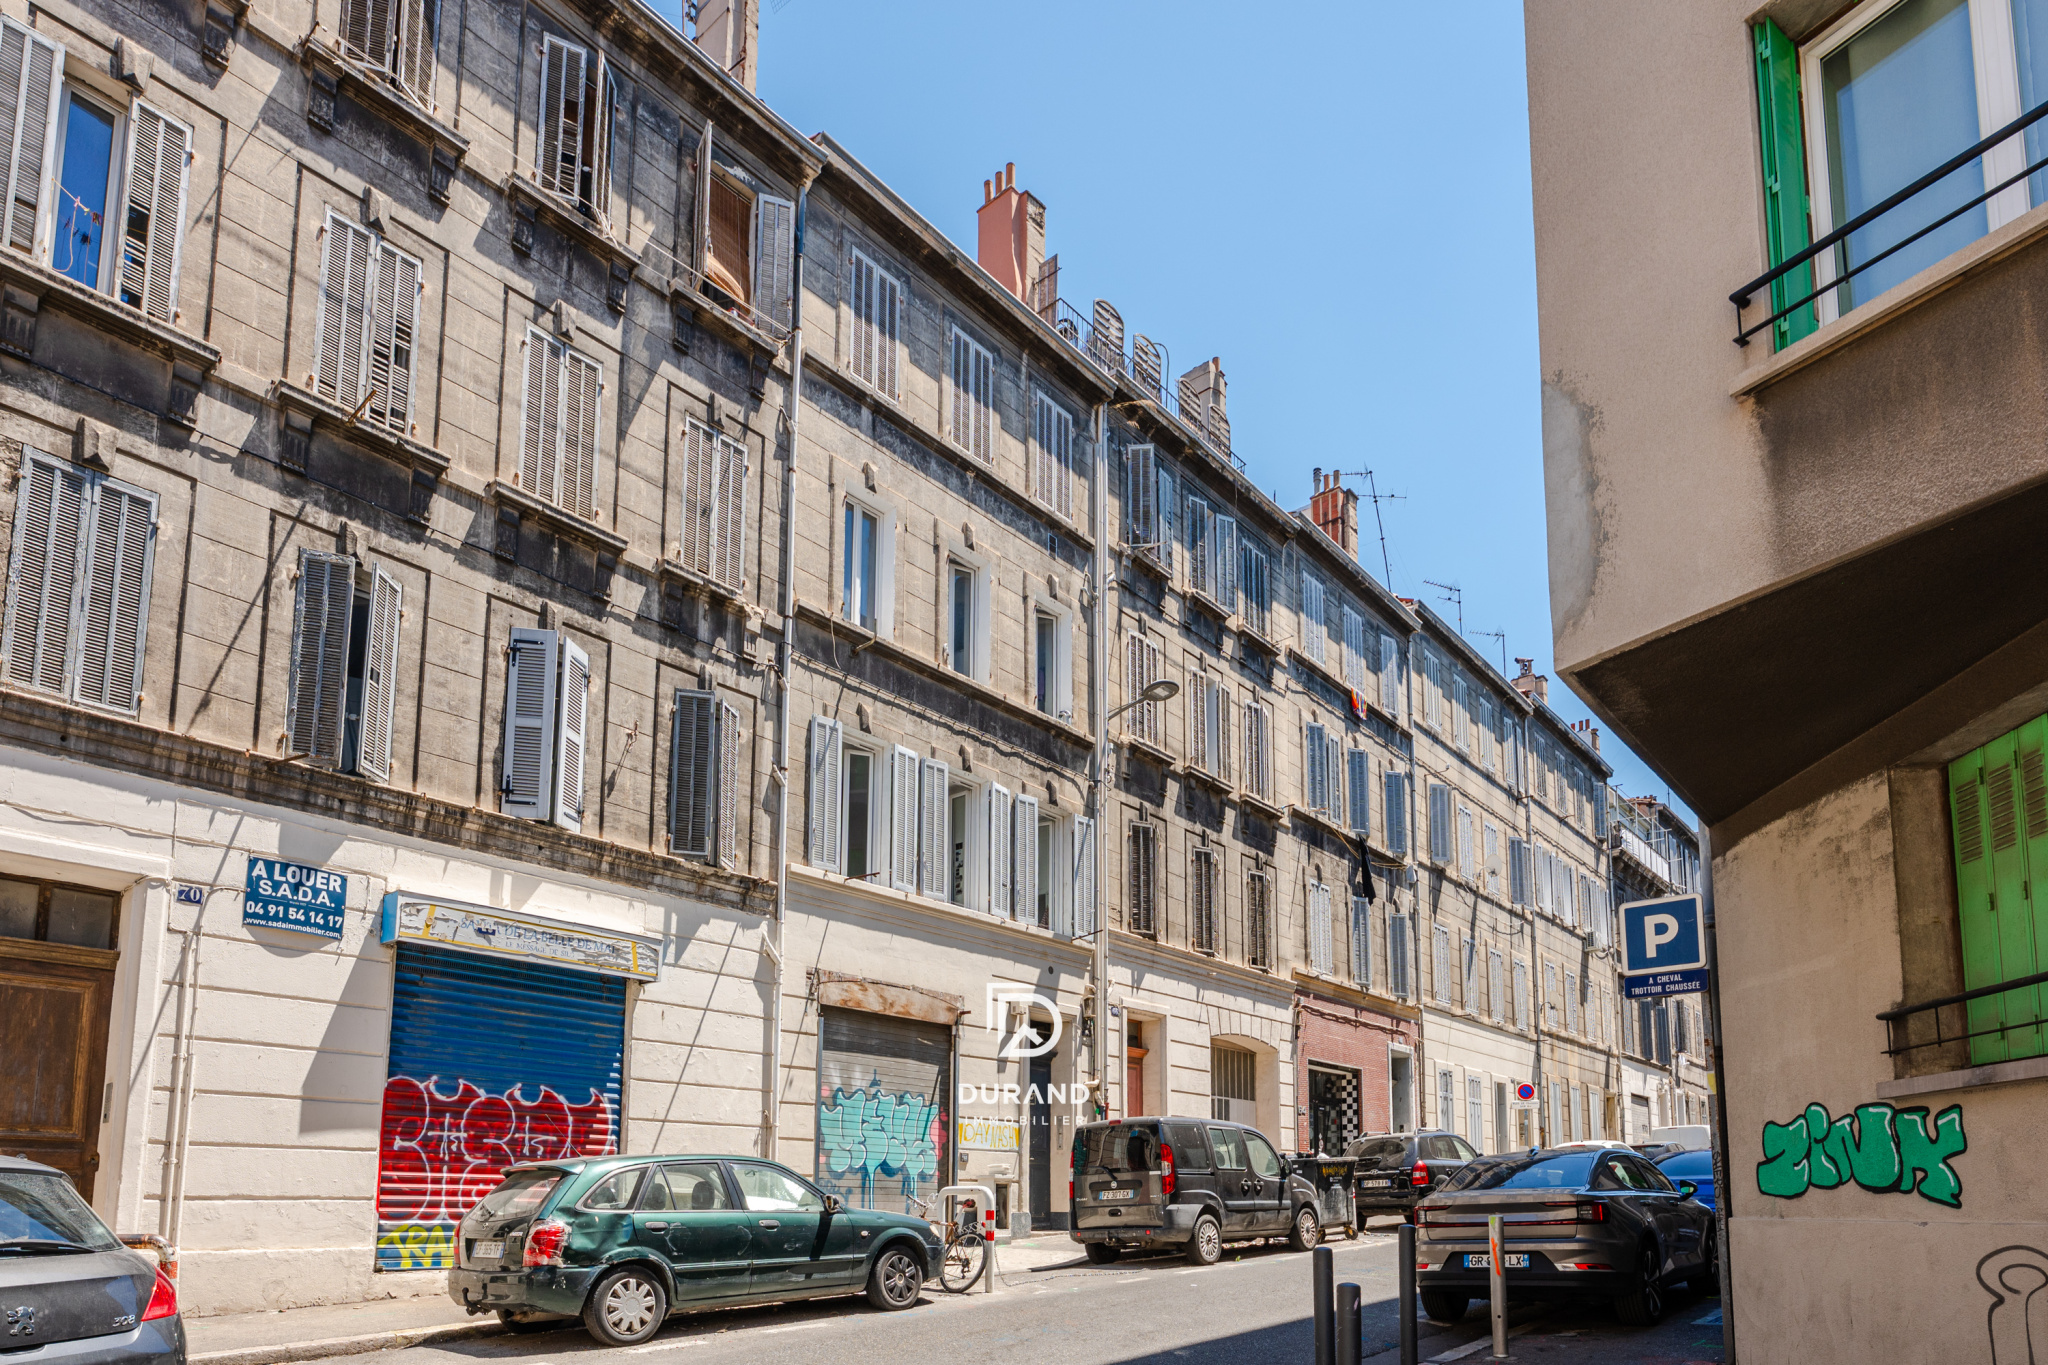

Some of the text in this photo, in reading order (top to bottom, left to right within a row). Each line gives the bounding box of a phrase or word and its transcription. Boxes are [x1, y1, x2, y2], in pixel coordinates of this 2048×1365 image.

[252, 860, 342, 893] A LOUER
[178, 886, 201, 902] 70
[258, 880, 335, 908] S.A.D.A.
[246, 901, 343, 929] 04 91 54 14 17
[246, 917, 341, 938] www.sadaimmobilier.com
[1644, 913, 1679, 959] P
[523, 928, 541, 942] LA
[577, 938, 592, 951] DE
[1631, 981, 1701, 996] TROTTOIR CHAUSSÉE
[1649, 973, 1682, 985] A CHEVAL
[377, 1223, 456, 1269] TRA
[112, 1314, 136, 1328] 308
